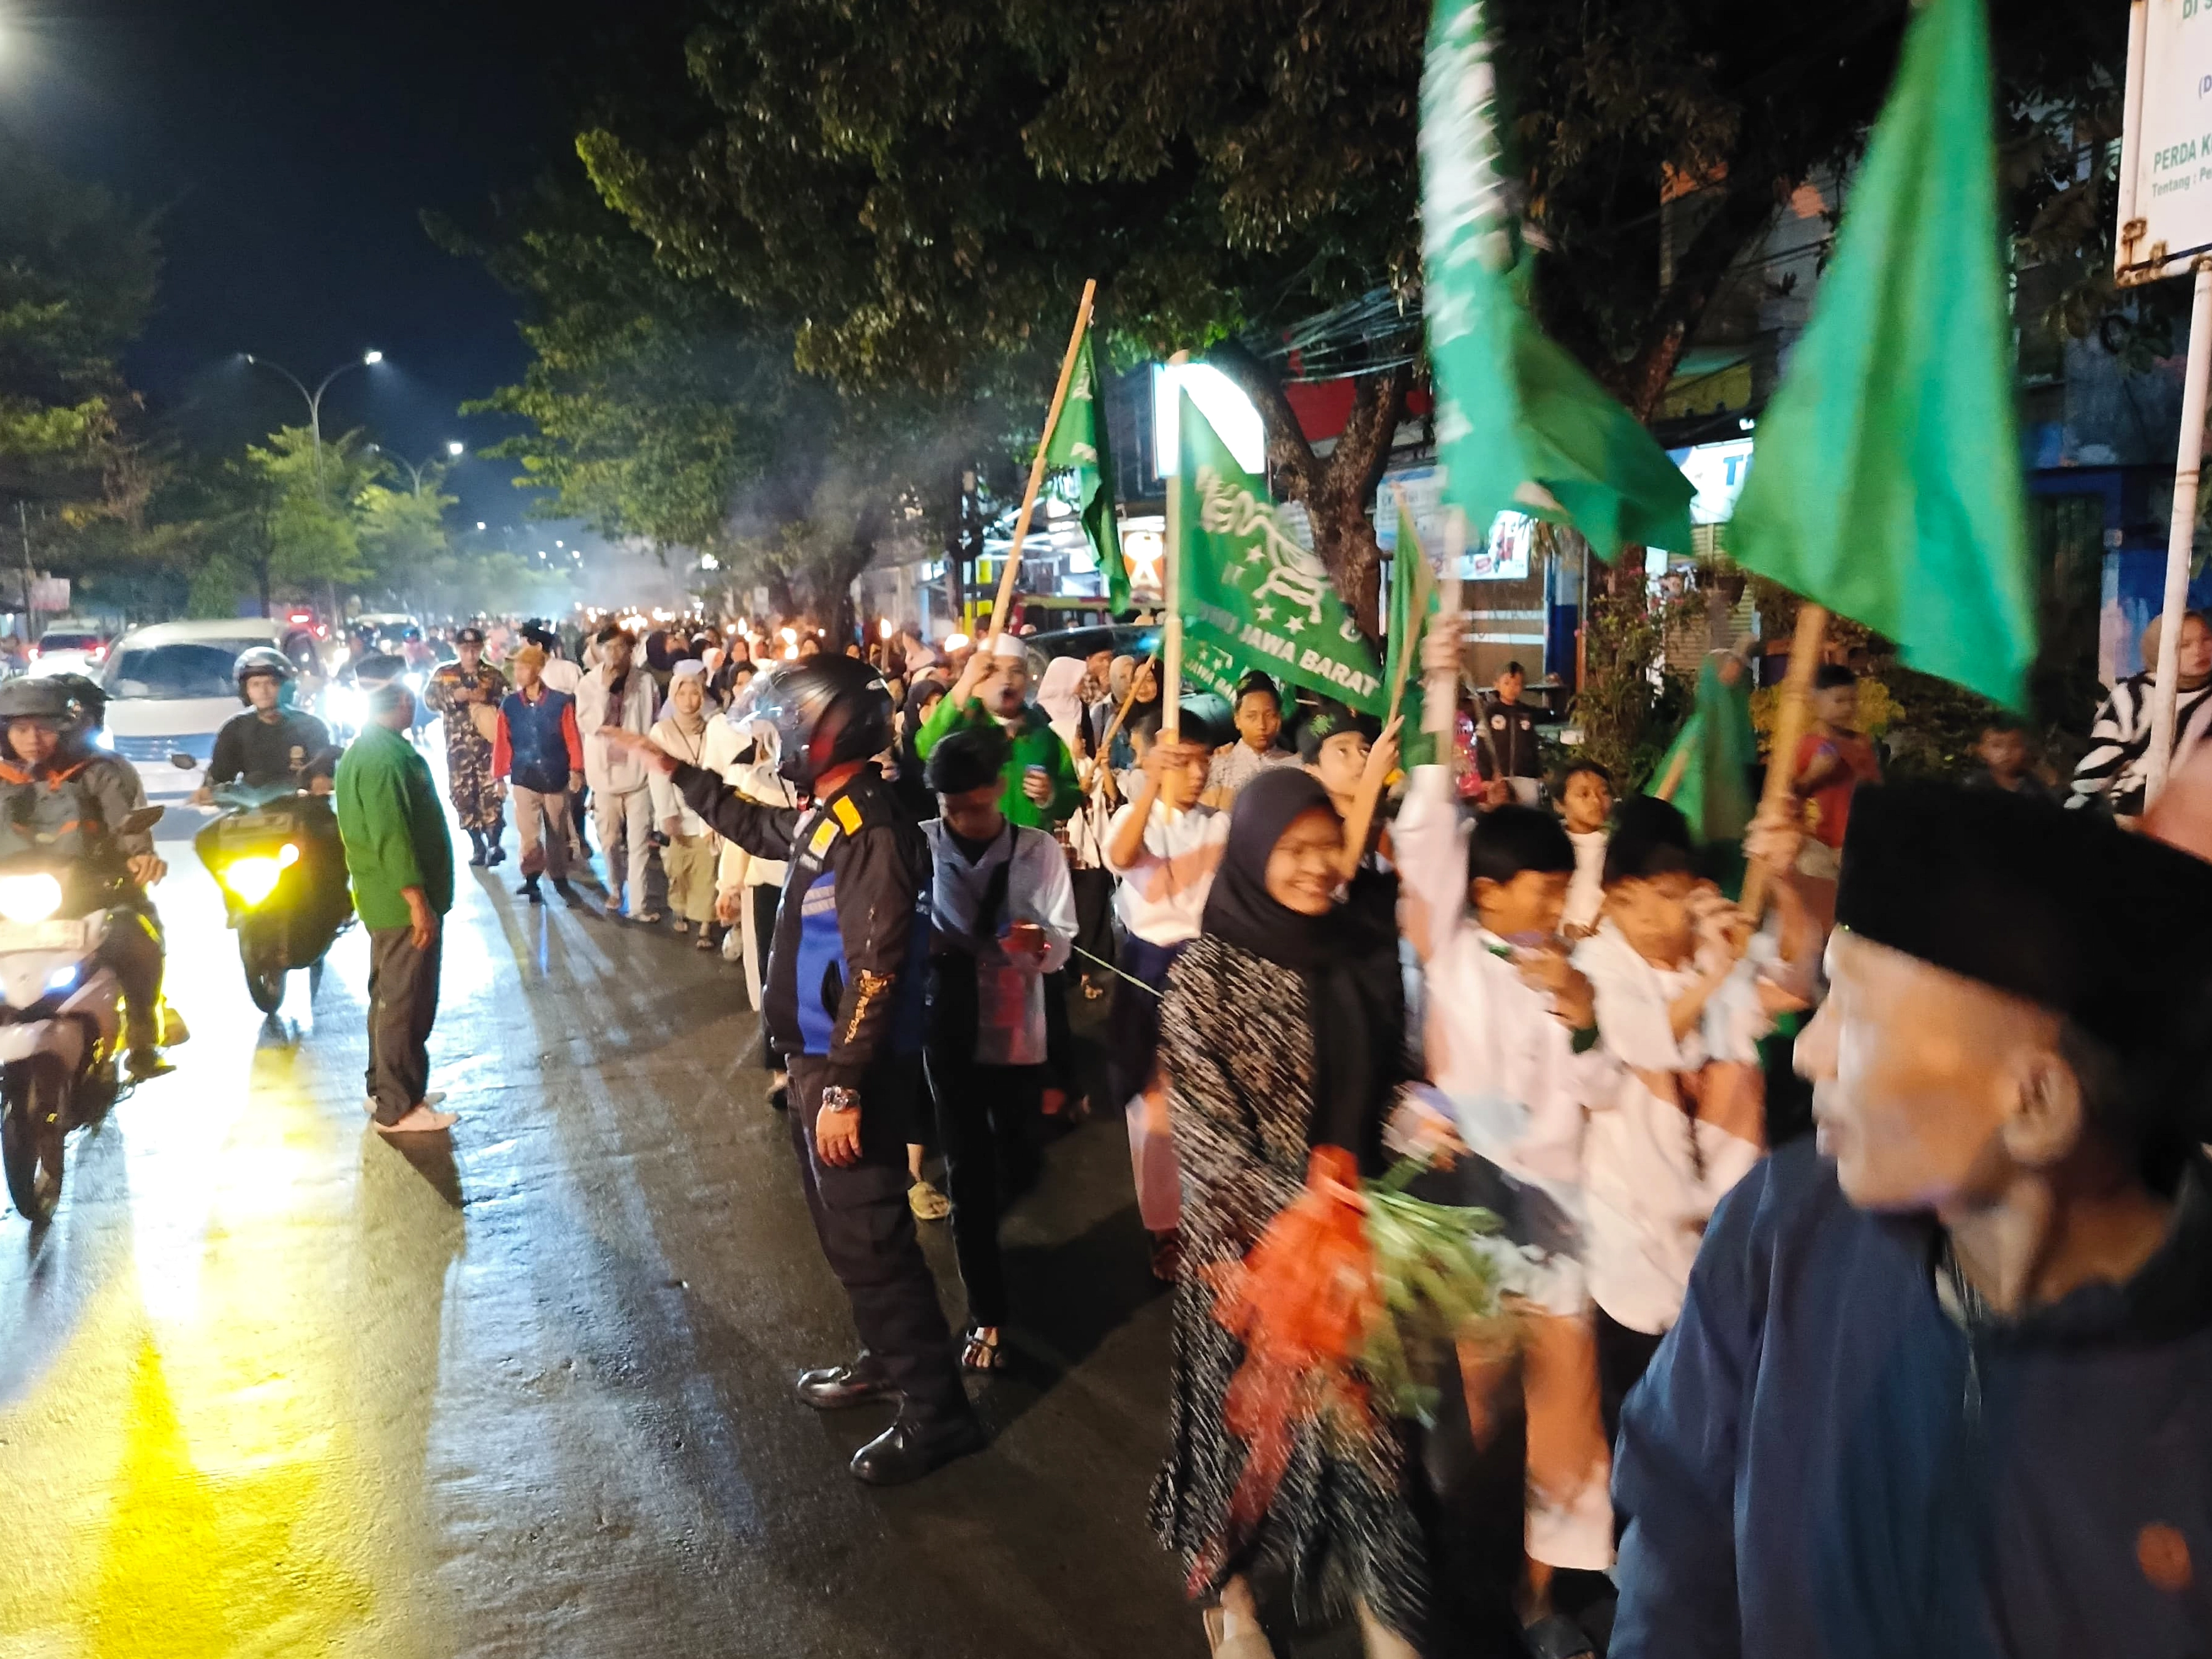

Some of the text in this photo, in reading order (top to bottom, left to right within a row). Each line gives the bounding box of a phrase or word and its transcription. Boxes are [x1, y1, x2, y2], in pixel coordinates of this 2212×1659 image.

[2153, 133, 2212, 174] PERDA K
[2152, 176, 2190, 198] Tentang
[1238, 623, 1381, 698] JAWA BARAT
